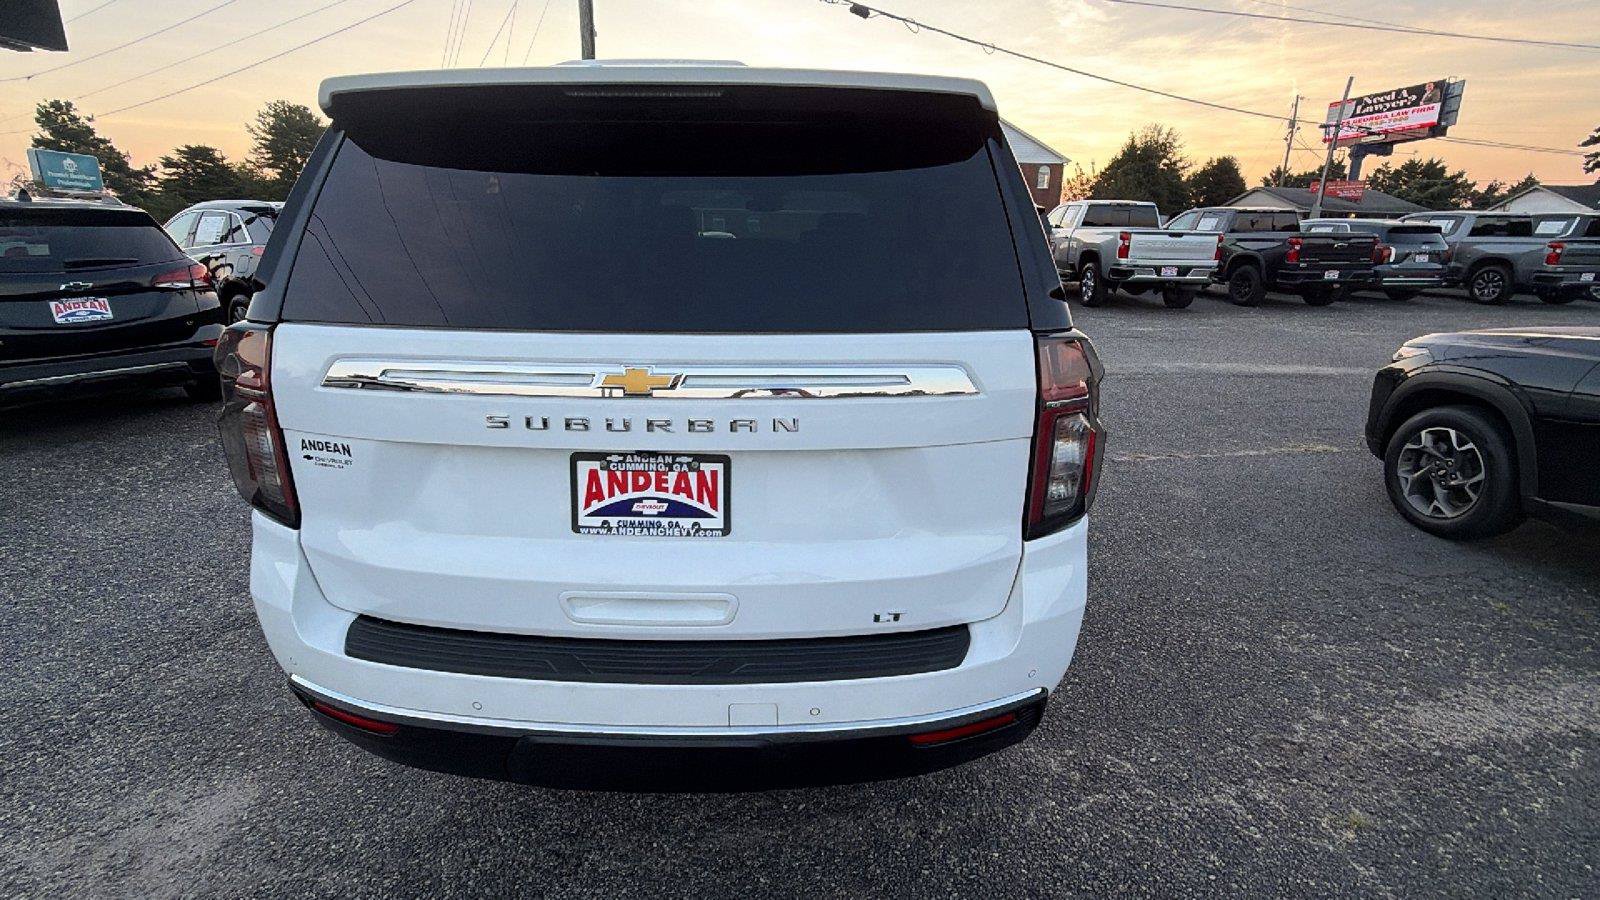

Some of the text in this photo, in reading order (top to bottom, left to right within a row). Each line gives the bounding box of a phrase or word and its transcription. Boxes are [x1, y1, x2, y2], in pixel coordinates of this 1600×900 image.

[1363, 92, 1396, 106] Need
[1352, 115, 1389, 125] GEORGIA
[1391, 109, 1409, 118] LAW
[1411, 104, 1436, 114] FIRM
[55, 300, 109, 316] ANDEAN
[486, 414, 799, 433] SUBURBAN
[301, 438, 352, 457] ANDEAN
[609, 462, 689, 472] CUMMING, GA
[583, 468, 719, 513] ANDEAN
[580, 526, 722, 537] www.ANDEANCHEVY.com
[873, 612, 907, 623] LT
